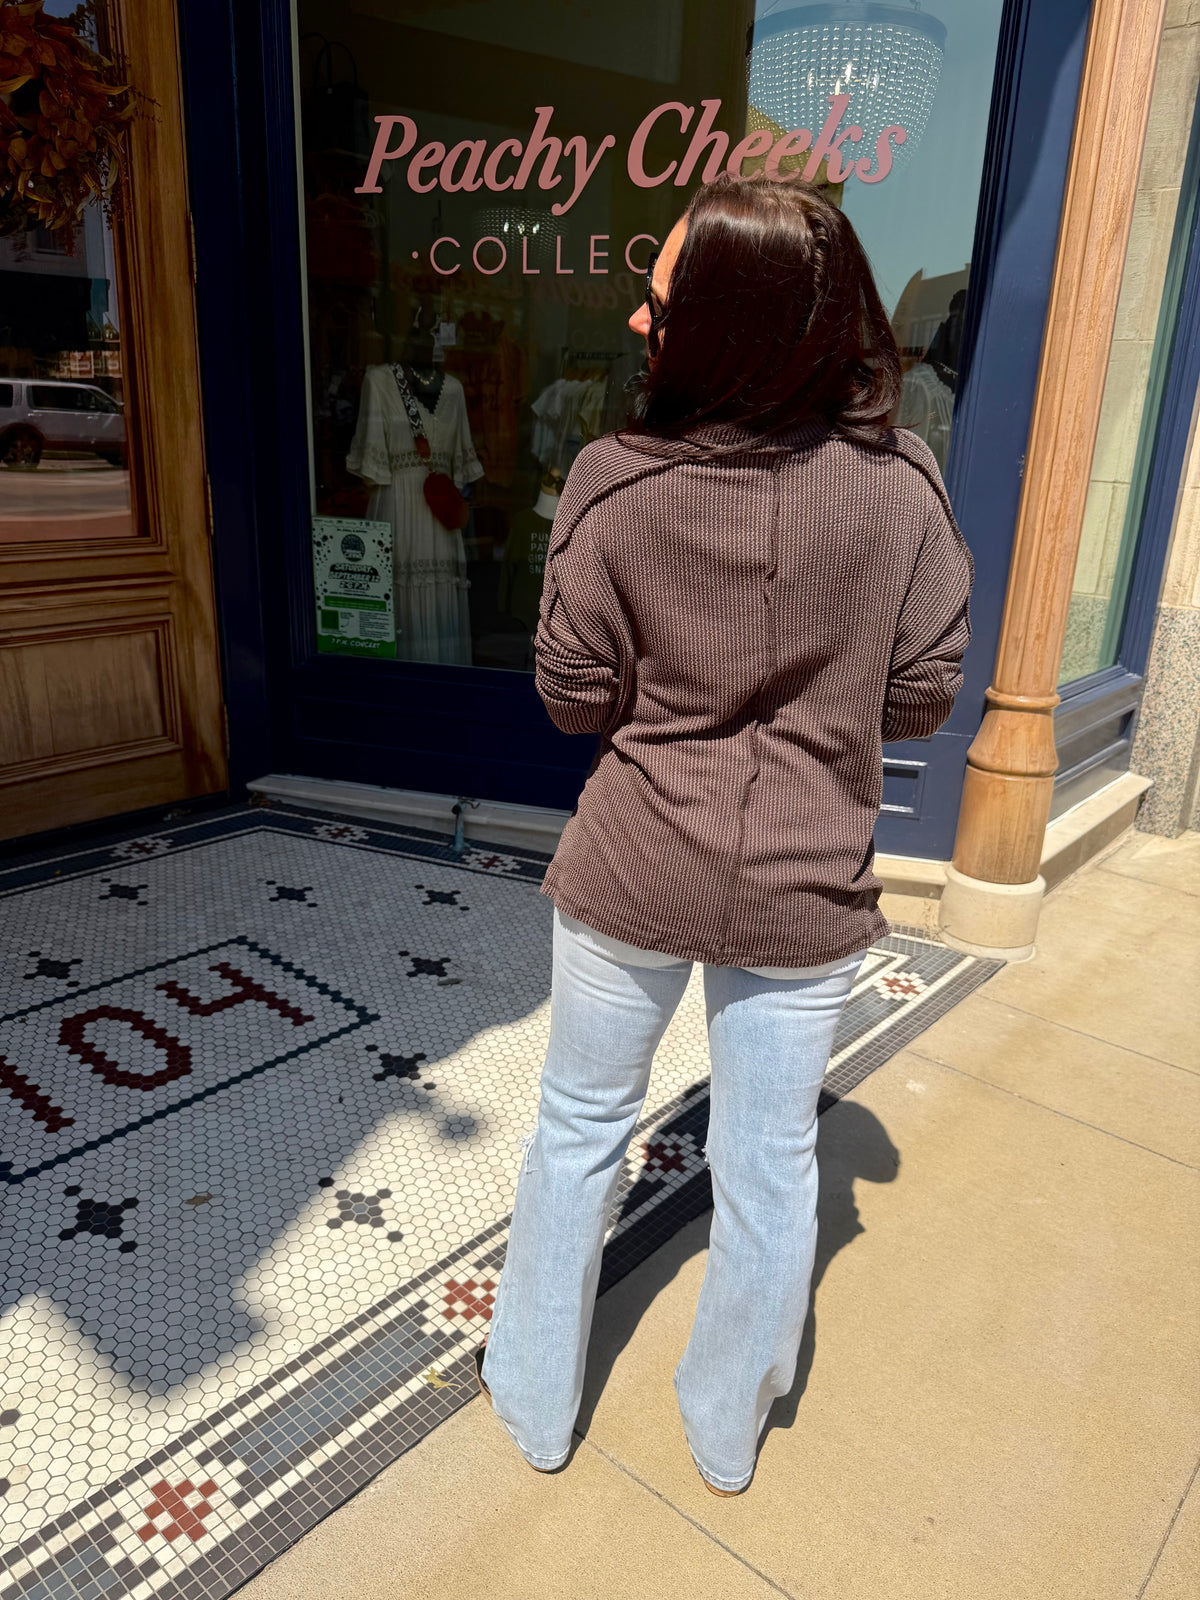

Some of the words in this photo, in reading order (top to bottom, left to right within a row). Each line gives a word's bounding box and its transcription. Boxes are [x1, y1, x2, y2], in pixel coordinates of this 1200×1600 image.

[354, 106, 616, 216] Peachy
[627, 95, 907, 189] Cheeks
[350, 640, 380, 648] CONCERT
